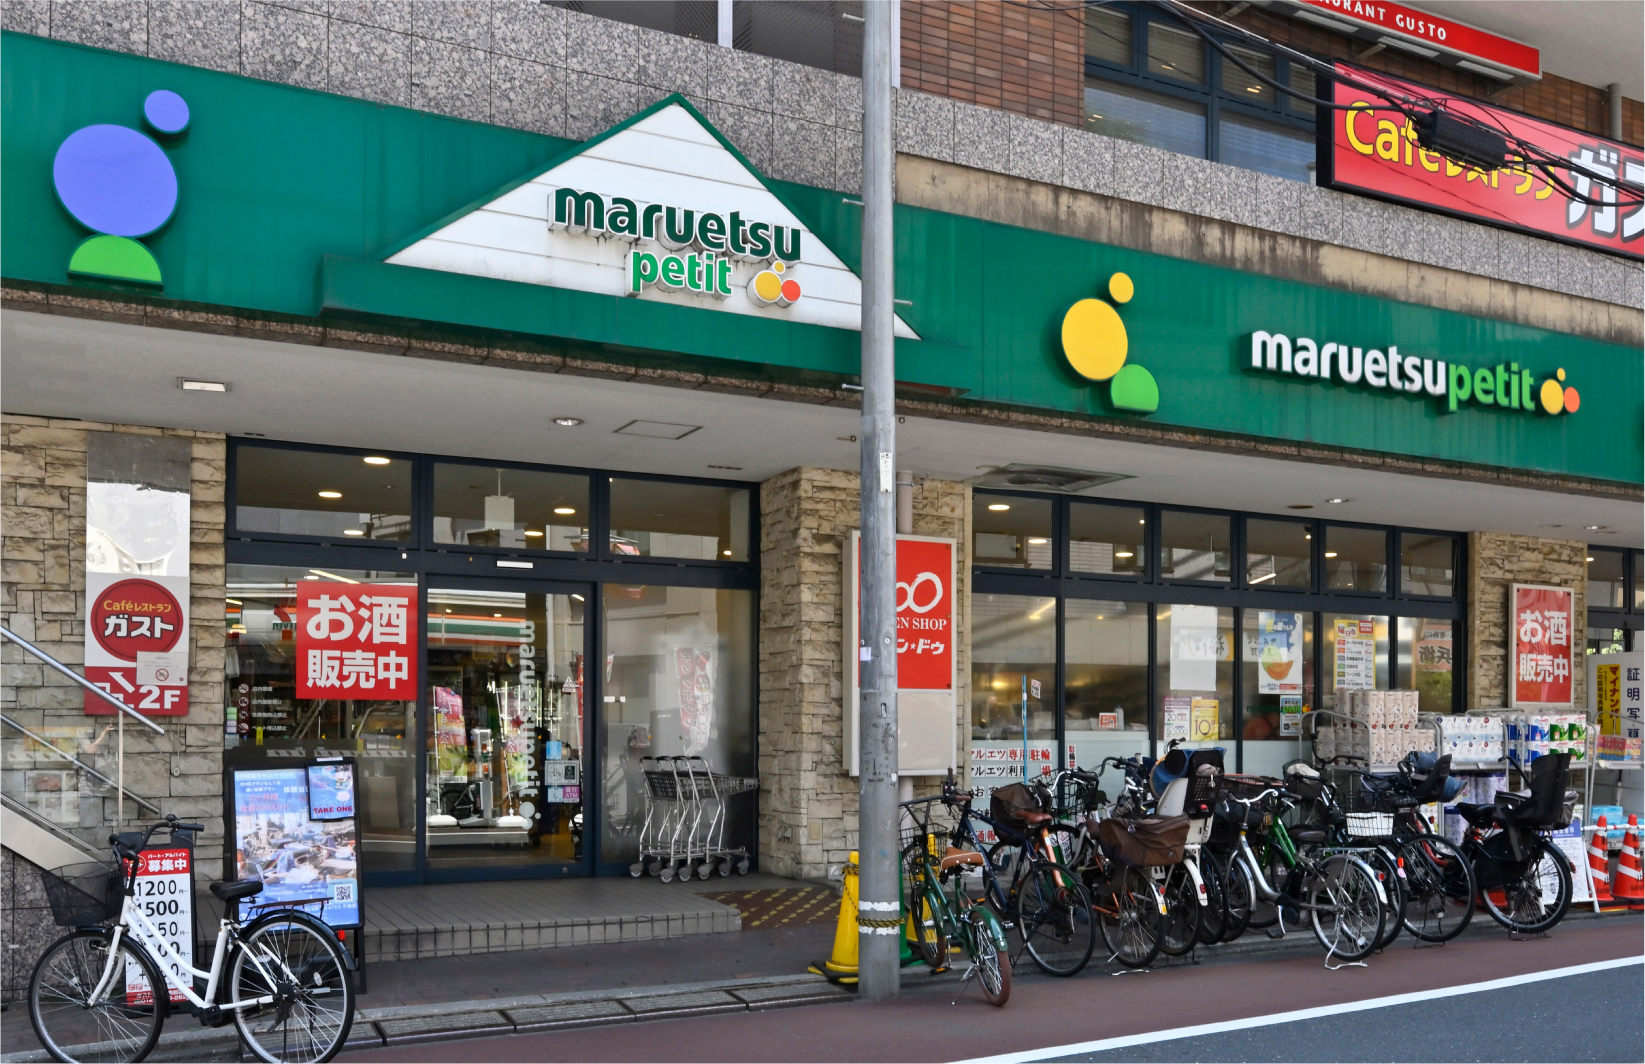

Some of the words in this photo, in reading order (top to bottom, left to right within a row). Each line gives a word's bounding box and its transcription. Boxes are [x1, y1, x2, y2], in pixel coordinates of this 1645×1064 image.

[1395, 13, 1447, 41] GUSTO
[553, 187, 801, 262] maruetsu
[631, 248, 733, 296] petit
[104, 614, 174, 638] ガスト
[306, 594, 409, 645] お酒
[912, 617, 947, 631] SHOP
[1519, 609, 1568, 647] お酒
[306, 649, 409, 690] 販売中
[1519, 653, 1569, 684] 販売中
[138, 684, 181, 710] 2F
[313, 806, 335, 814] TAKE
[147, 858, 187, 873] 募集中
[136, 879, 177, 897] 1200
